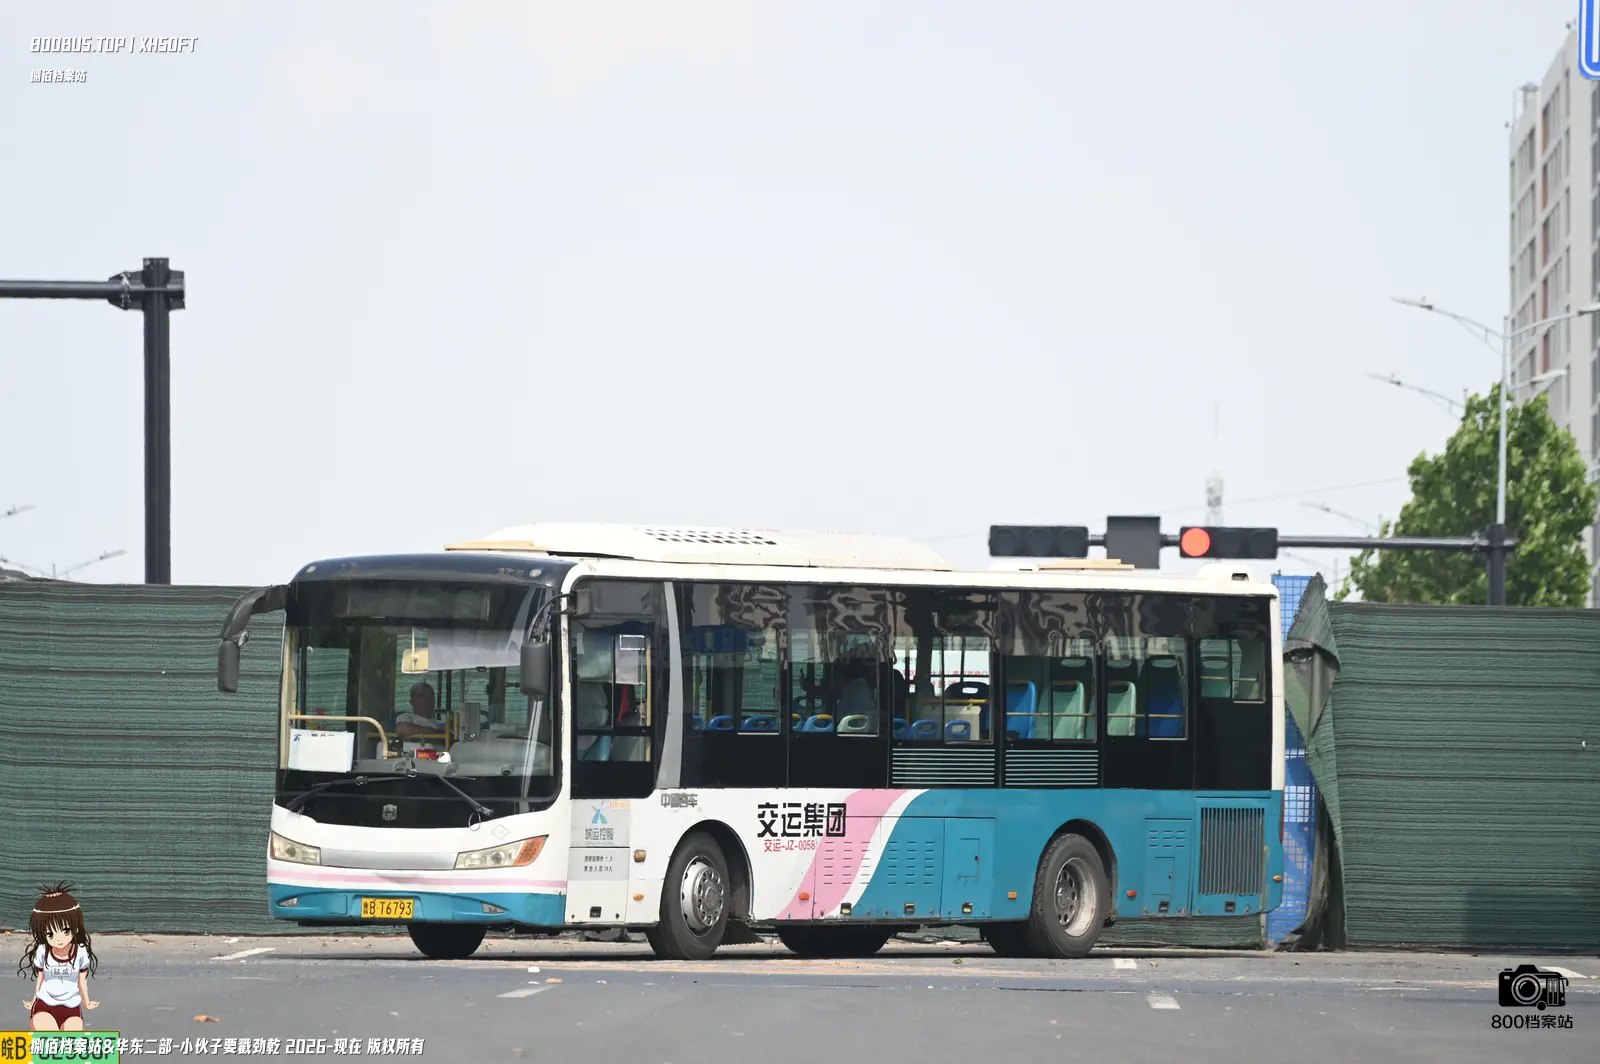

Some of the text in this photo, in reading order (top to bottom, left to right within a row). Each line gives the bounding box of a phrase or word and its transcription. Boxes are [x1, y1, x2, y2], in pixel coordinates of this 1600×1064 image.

[757, 802, 847, 838] 交运集团
[763, 839, 816, 853] 交运-JZ-0058
